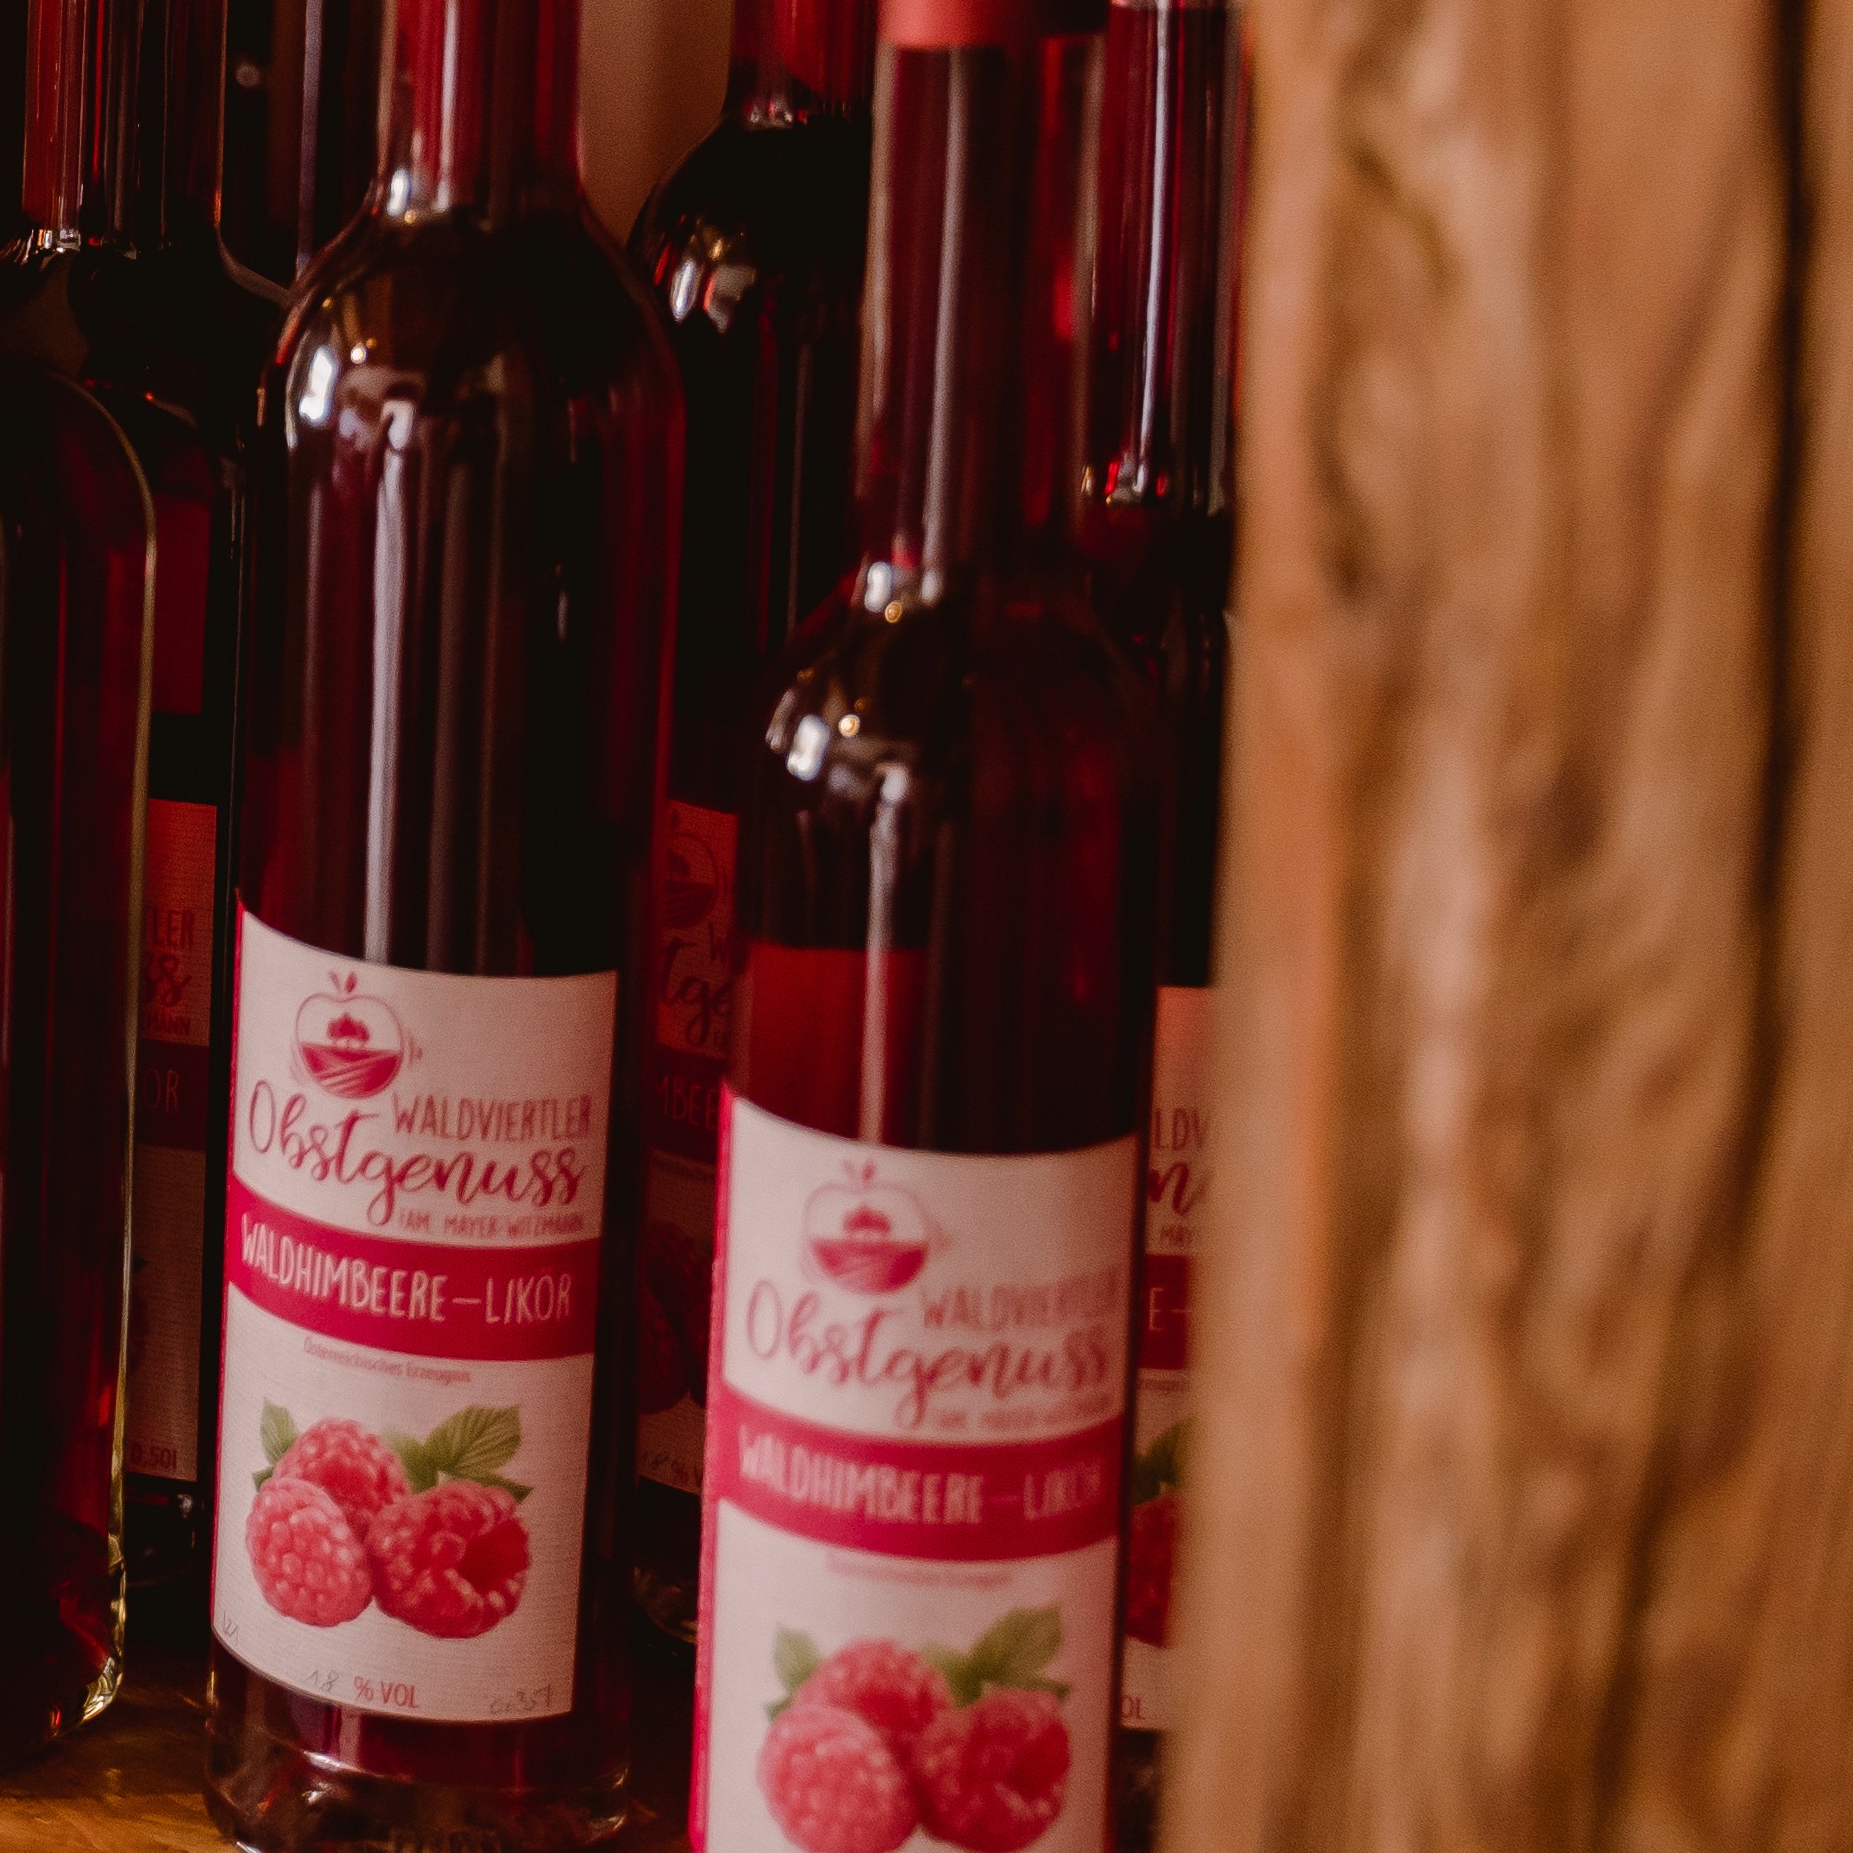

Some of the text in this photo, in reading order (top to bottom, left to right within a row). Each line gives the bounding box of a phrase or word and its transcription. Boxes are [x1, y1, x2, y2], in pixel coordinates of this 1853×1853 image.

[249, 1079, 585, 1226] Obstgenuss
[392, 1093, 591, 1143] WALDVIERTLER
[745, 1278, 1110, 1429] Obstgenuss
[353, 1675, 375, 1702] %
[380, 1679, 420, 1710] VOL
